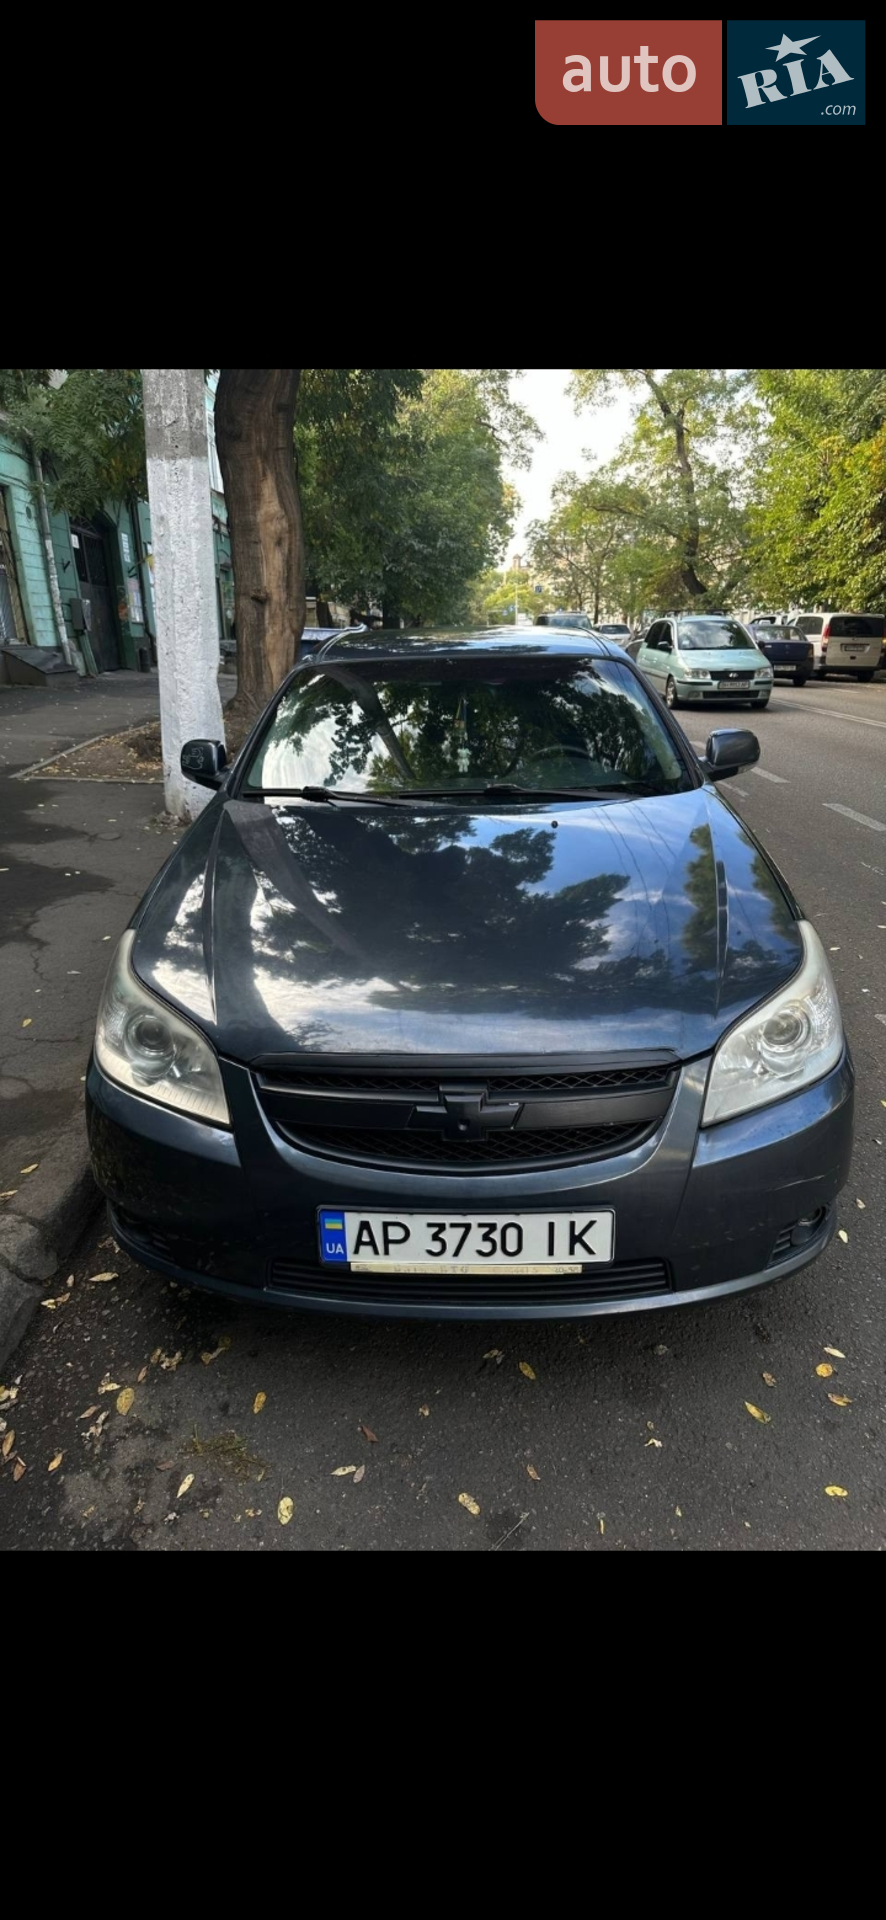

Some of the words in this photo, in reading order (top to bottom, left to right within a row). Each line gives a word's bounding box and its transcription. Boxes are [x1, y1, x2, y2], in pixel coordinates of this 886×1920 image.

[326, 1243, 345, 1255] UA
[352, 1220, 411, 1256] AP
[425, 1221, 524, 1258] 3730
[547, 1220, 597, 1257] IK
